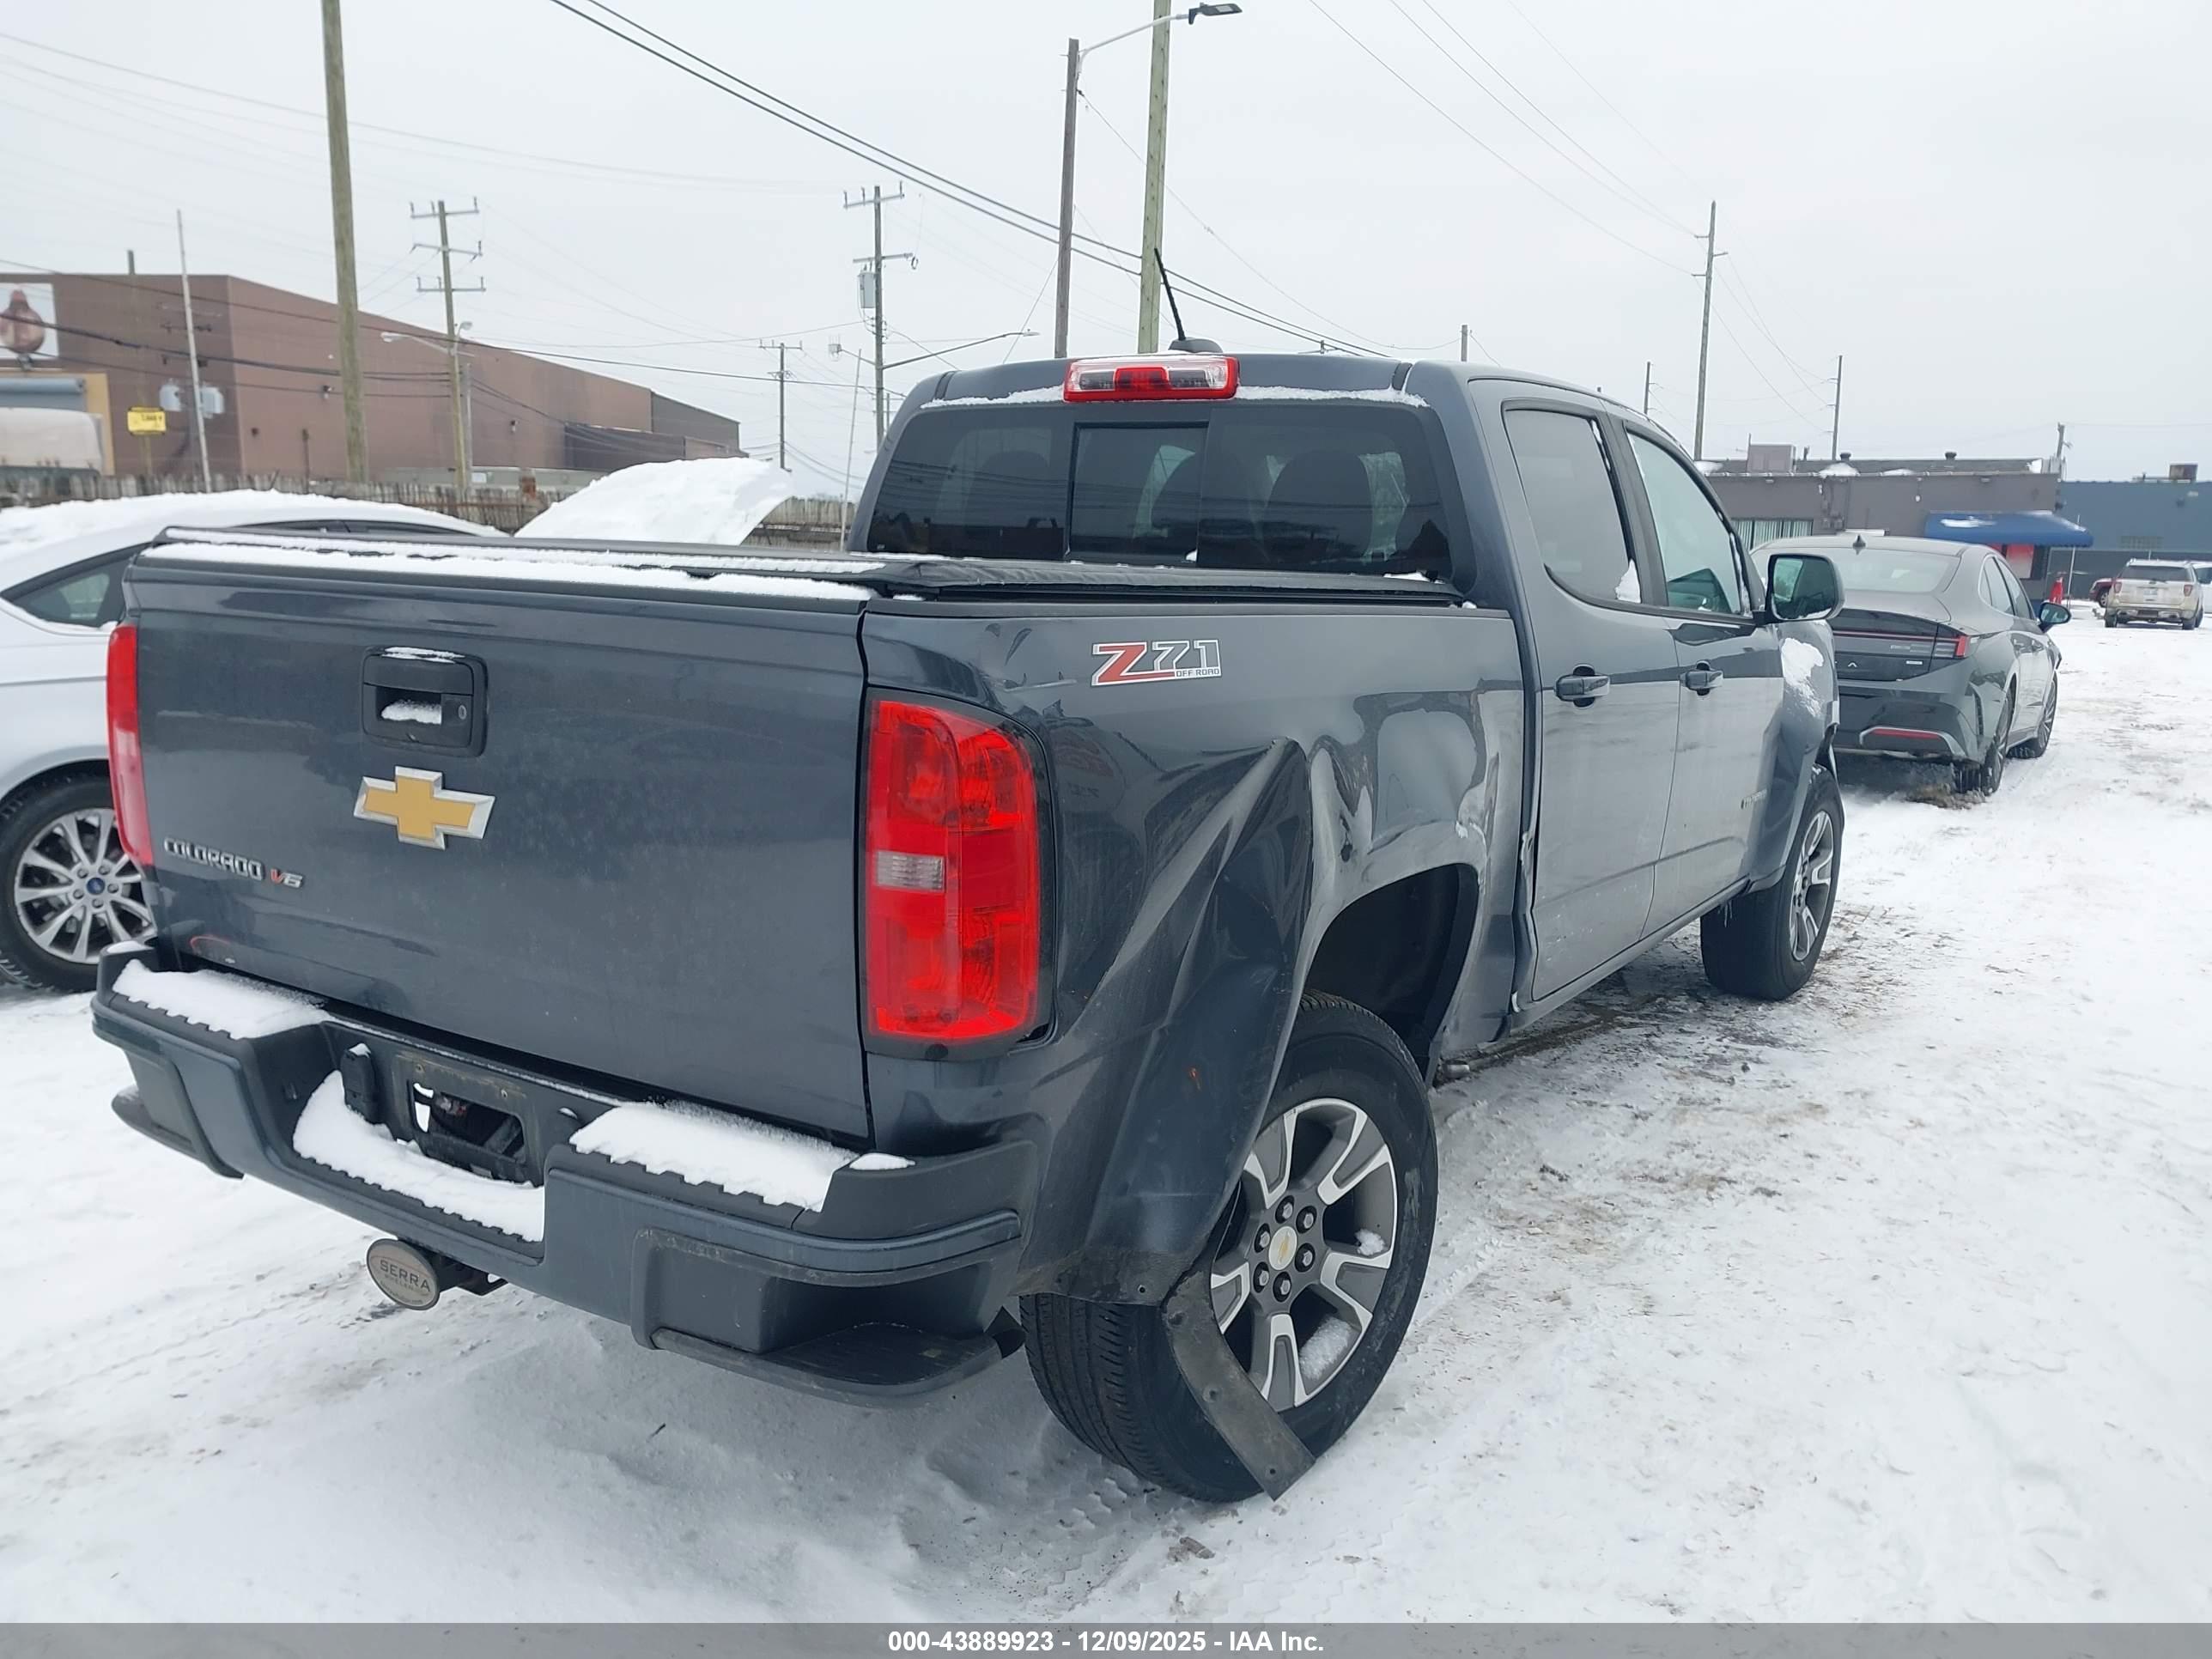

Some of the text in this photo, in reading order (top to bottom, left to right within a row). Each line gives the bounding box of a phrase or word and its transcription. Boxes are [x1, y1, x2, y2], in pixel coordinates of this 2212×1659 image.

[1091, 640, 1221, 686] Z71
[1176, 667, 1220, 678] OFF ROAD
[164, 837, 303, 889] COLORADO V6
[380, 1259, 431, 1292] SERRA
